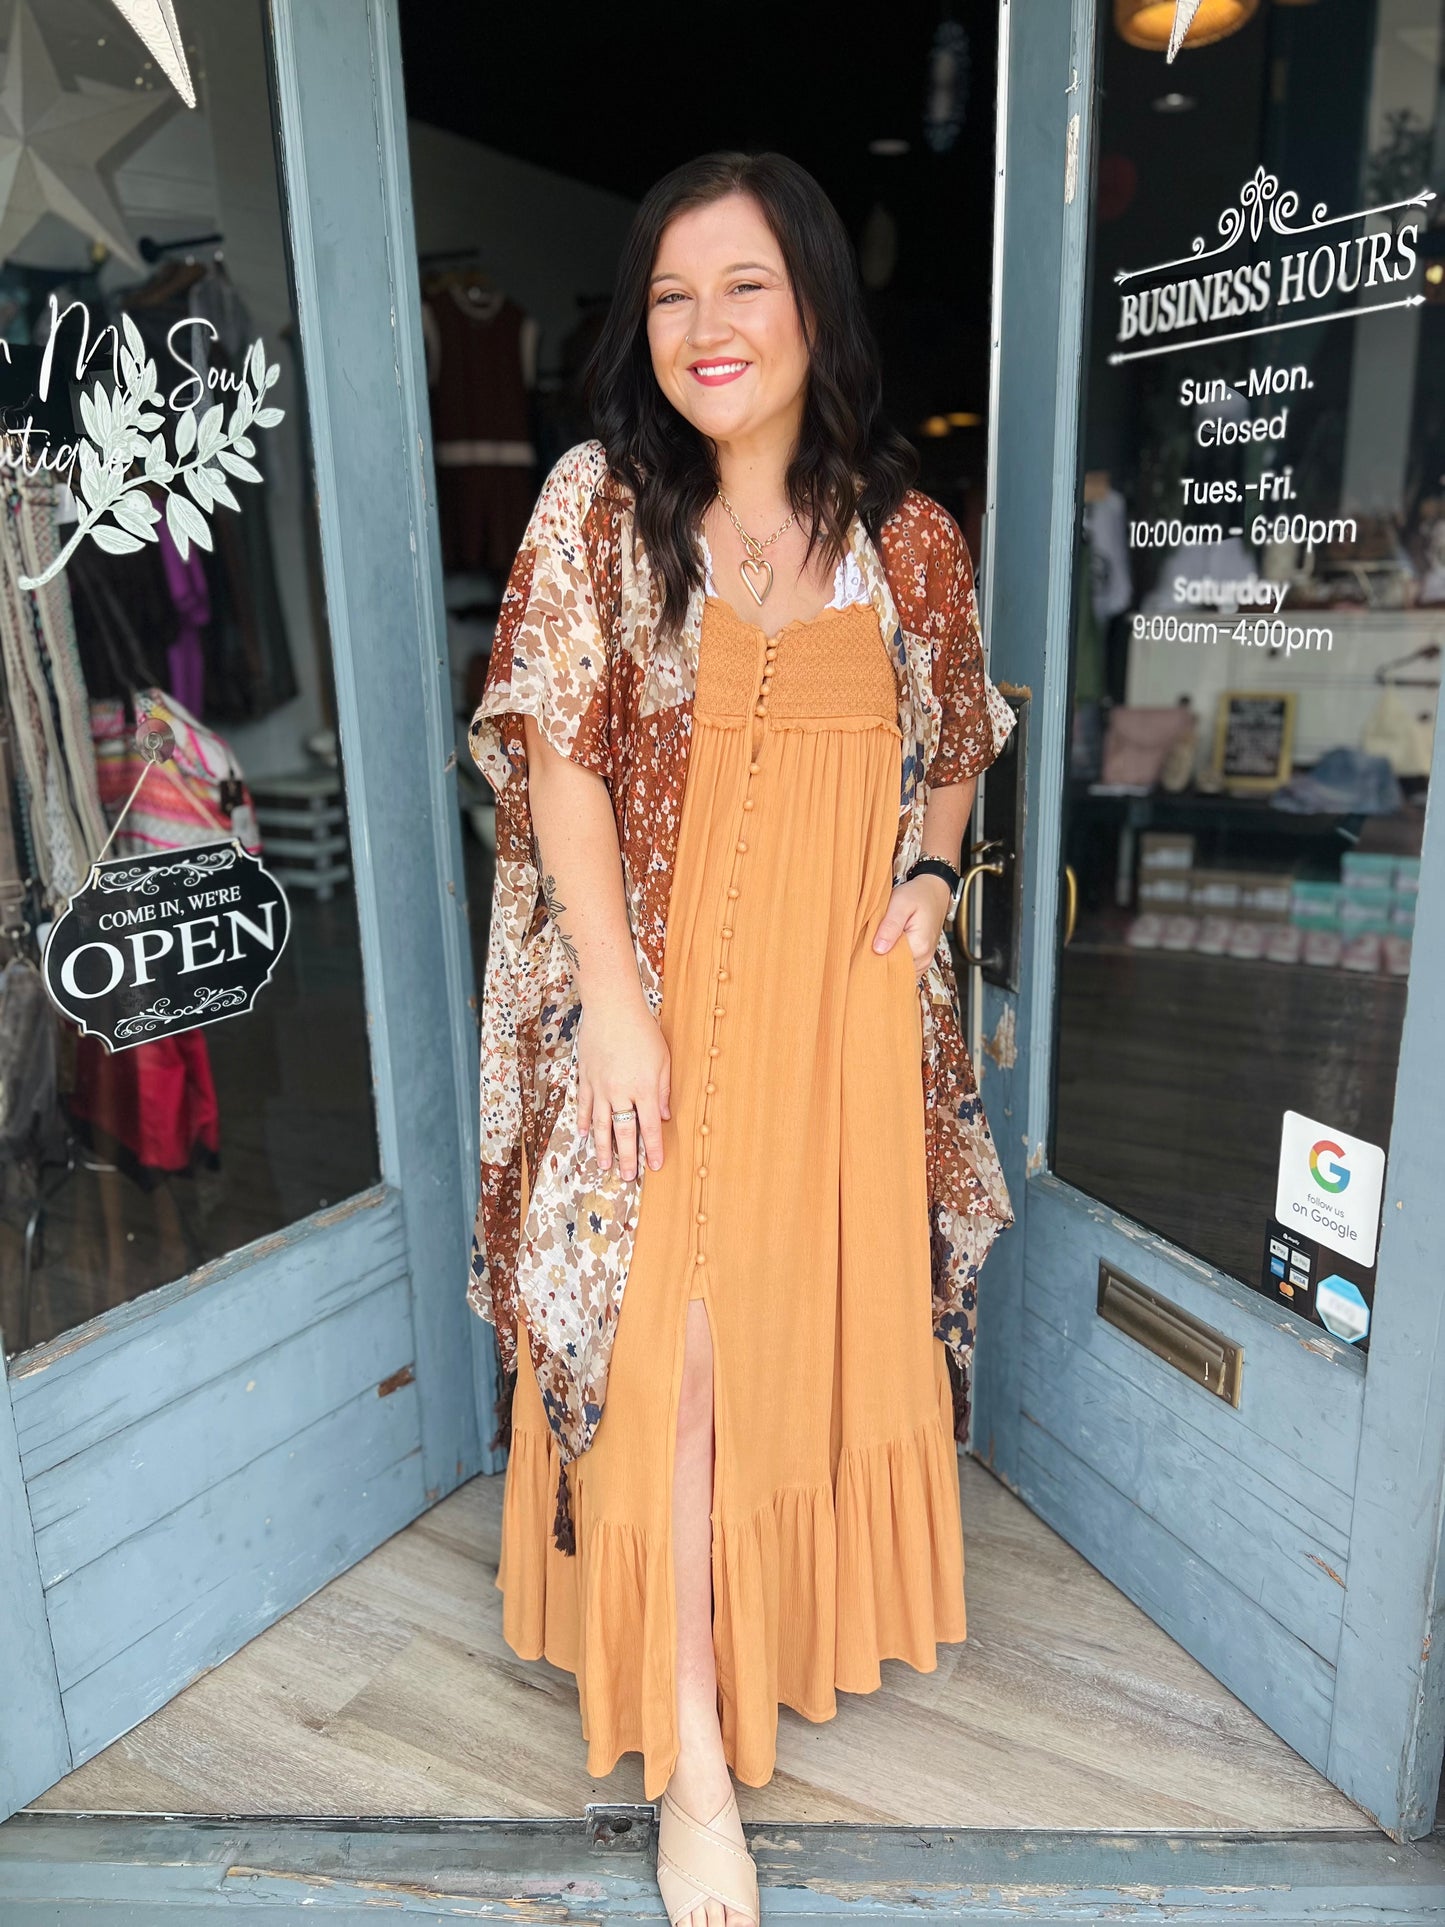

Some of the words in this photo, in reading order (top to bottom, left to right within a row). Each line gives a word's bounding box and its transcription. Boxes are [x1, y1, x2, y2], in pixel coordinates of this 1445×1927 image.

[1117, 260, 1271, 342] BUSINESS
[1277, 224, 1419, 306] HOURS
[167, 317, 260, 412] Soul
[1197, 406, 1288, 447] Closed
[1129, 520, 1222, 548] 10:00am
[1251, 514, 1358, 553] 6:00pm
[1173, 573, 1290, 614] Saturday
[1132, 614, 1334, 657] 9:00am-4:00pm
[99, 905, 157, 931] COME
[160, 899, 185, 919] IN,
[188, 885, 242, 911] WE'RE
[60, 901, 278, 1000] OPEN
[1309, 1139, 1351, 1194] G
[1292, 1202, 1308, 1217] on
[1311, 1208, 1358, 1241] Google
[1307, 1193, 1333, 1212] follow
[1334, 1208, 1345, 1218] us
